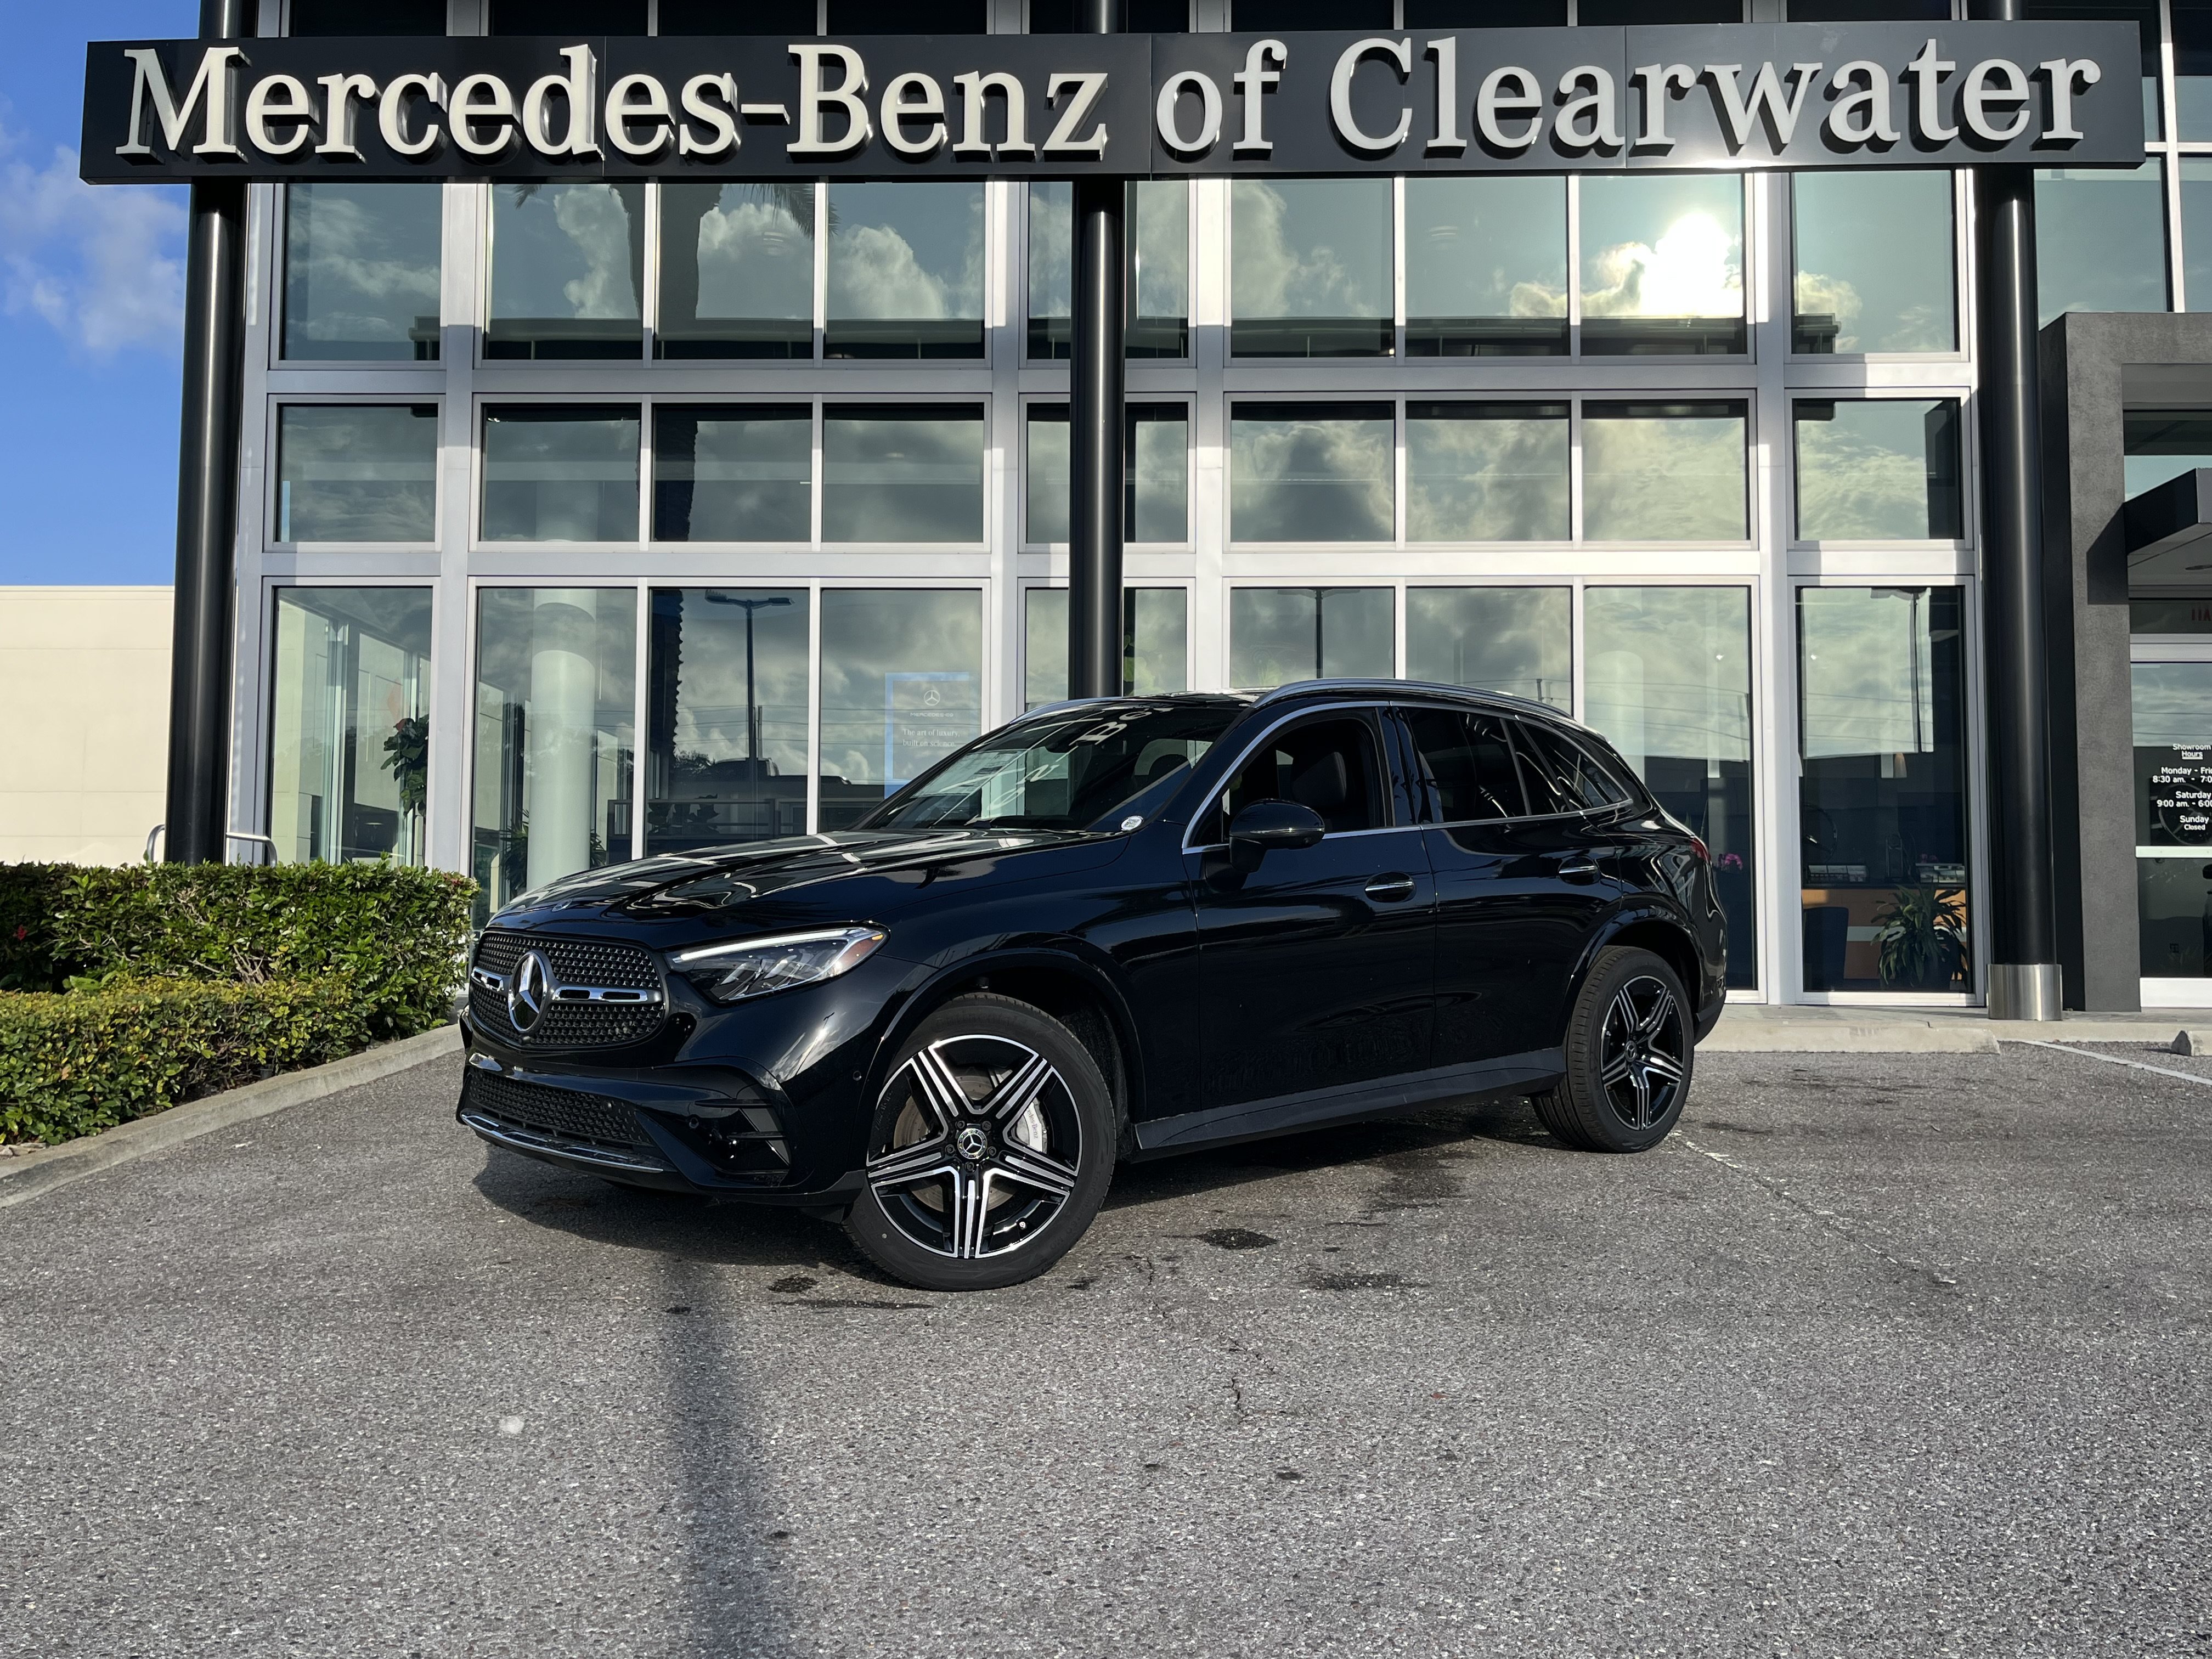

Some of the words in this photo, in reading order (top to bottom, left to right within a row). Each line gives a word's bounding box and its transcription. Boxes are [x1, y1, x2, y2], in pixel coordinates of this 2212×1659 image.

[114, 43, 1109, 158] Mercedes-Benz
[1156, 38, 1288, 153] of
[1329, 35, 2102, 151] Clearwater
[936, 729, 961, 737] luxury,
[902, 738, 918, 747] built
[2161, 766, 2192, 776] Monday
[2152, 775, 2171, 783] 8:30
[2175, 791, 2212, 800] Saturday
[2157, 799, 2174, 808] 9:00
[2180, 815, 2209, 824] Sunday
